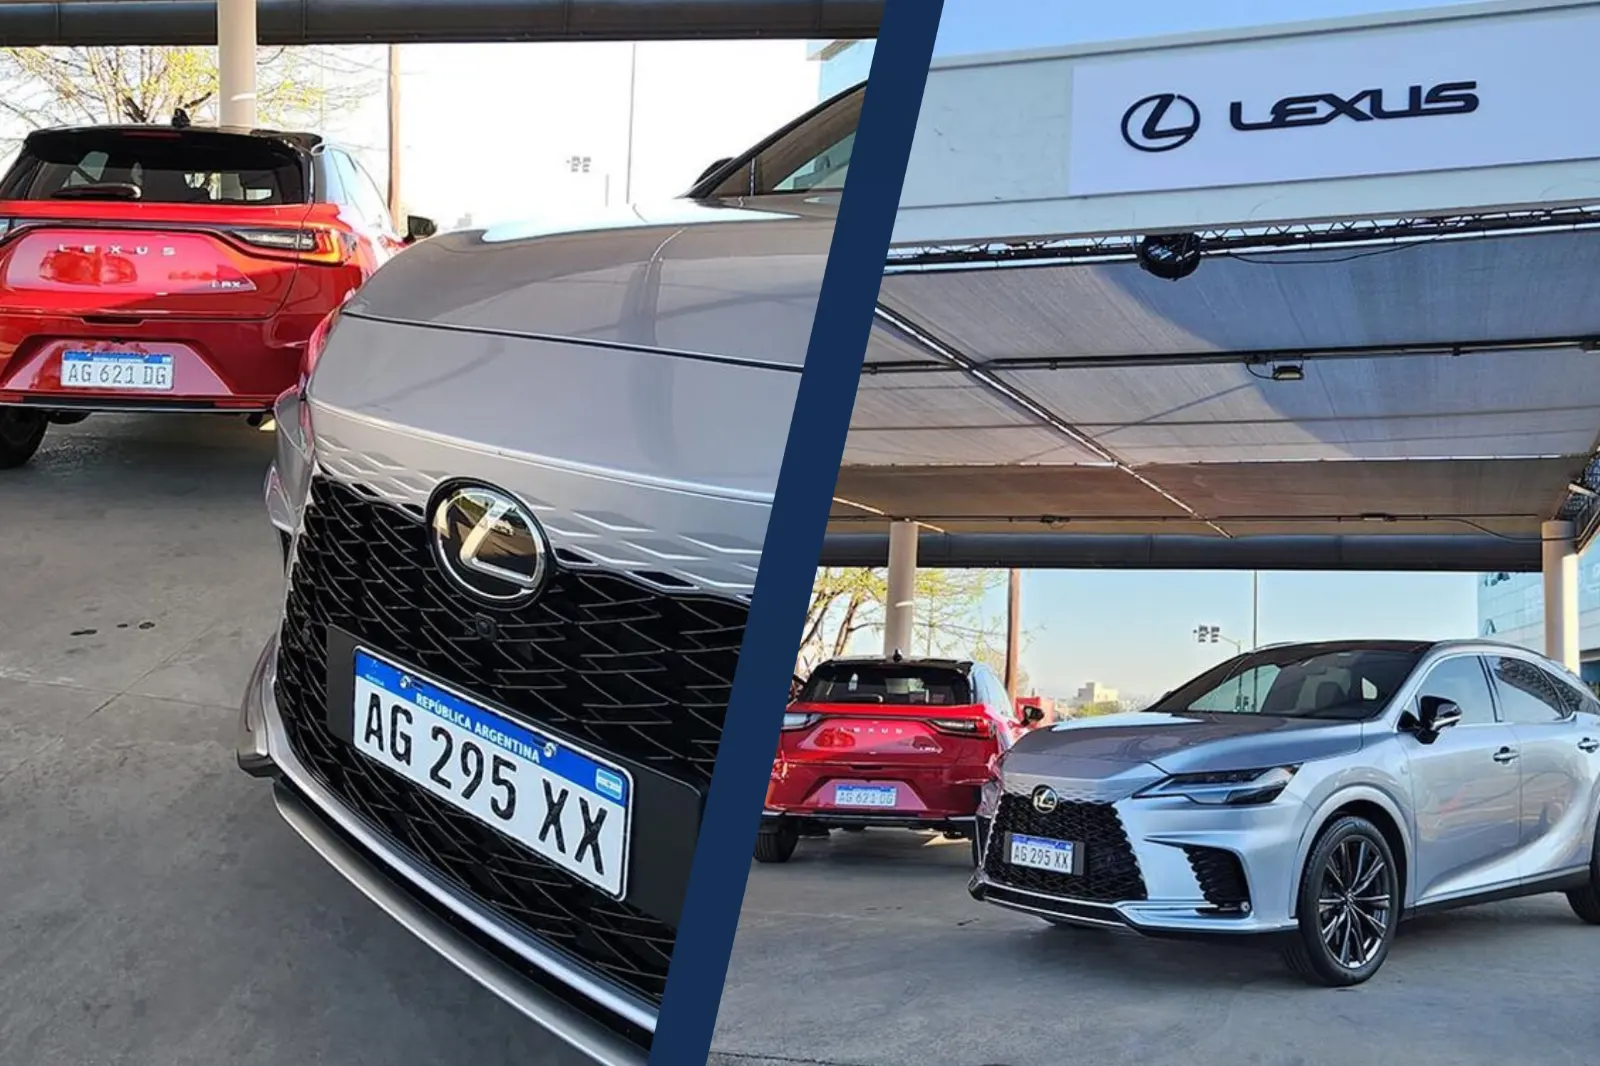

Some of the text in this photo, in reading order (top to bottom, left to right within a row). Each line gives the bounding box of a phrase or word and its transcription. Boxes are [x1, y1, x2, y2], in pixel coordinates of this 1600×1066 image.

[1229, 80, 1480, 132] LEXUS
[58, 244, 176, 256] LEXUS
[68, 363, 167, 385] AG 621 DG
[415, 693, 540, 764] REPÚBLICA ARGENTINA
[364, 692, 608, 876] AG 295 XX
[1013, 845, 1069, 869] AG 295 XX
